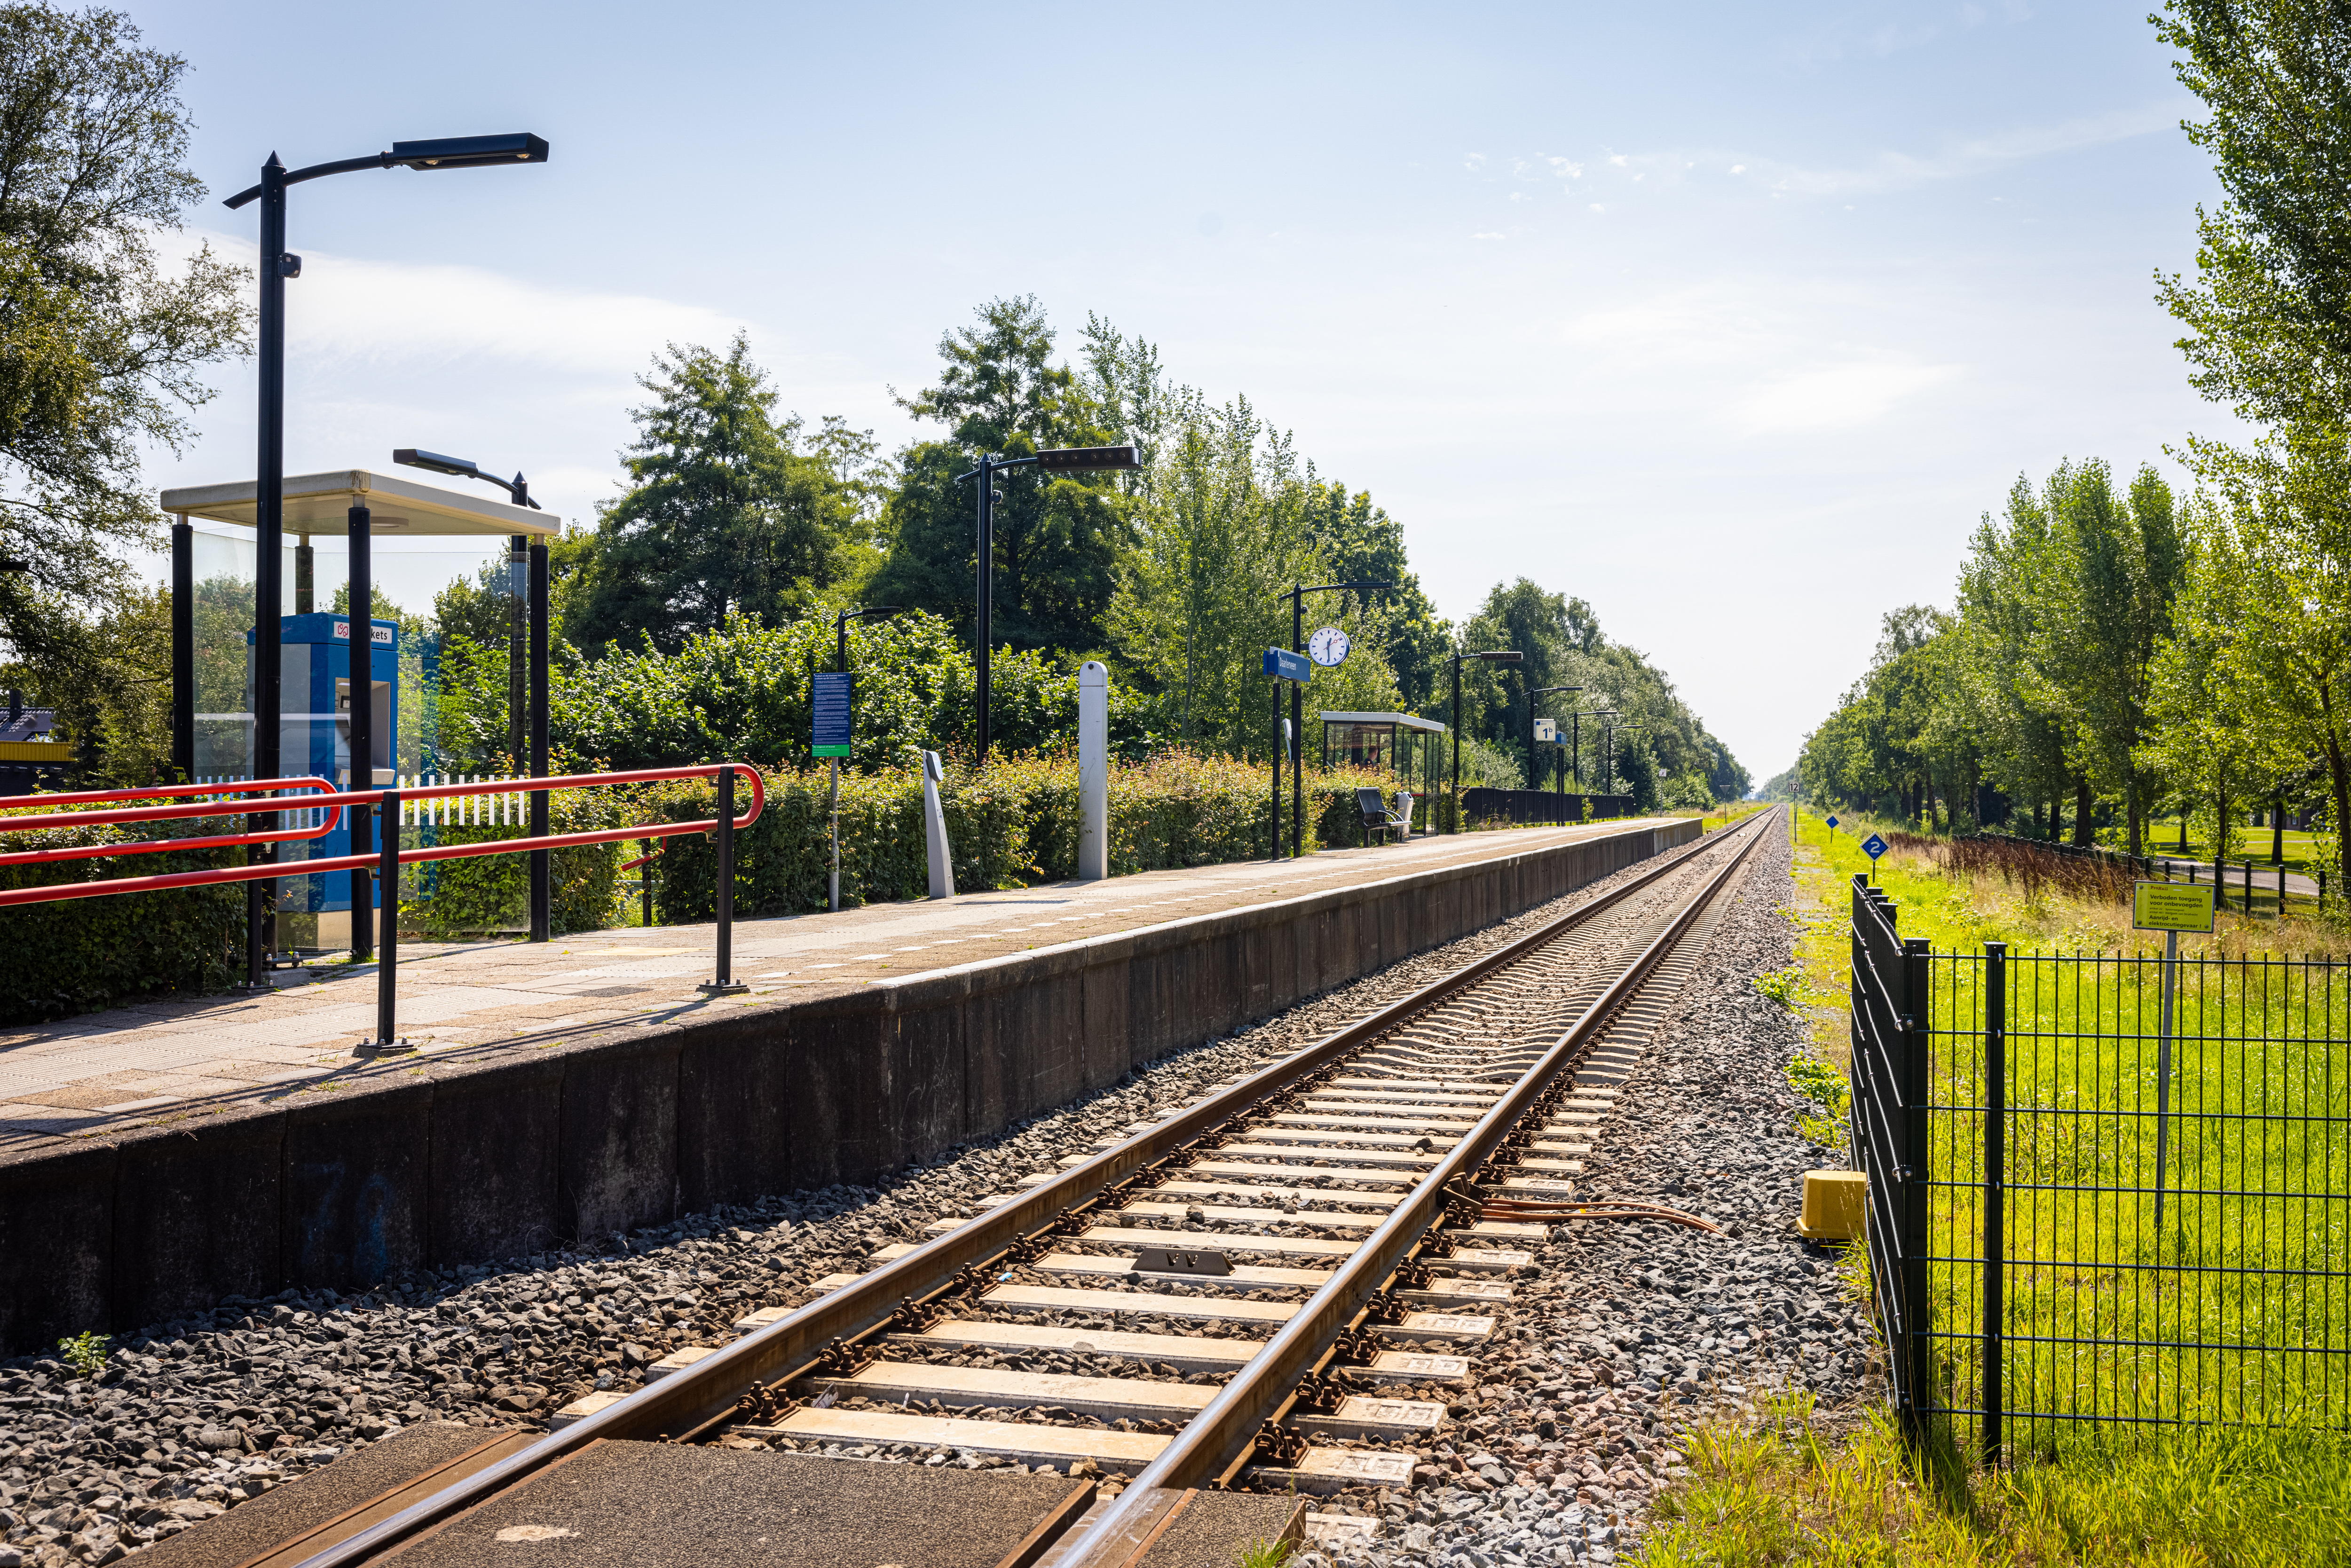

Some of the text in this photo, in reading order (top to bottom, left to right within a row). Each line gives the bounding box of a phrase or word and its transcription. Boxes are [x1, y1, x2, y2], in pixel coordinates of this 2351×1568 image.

[371, 628, 387, 640] kets
[1279, 657, 1296, 670] Daarlerveen
[1870, 841, 1880, 853] 2
